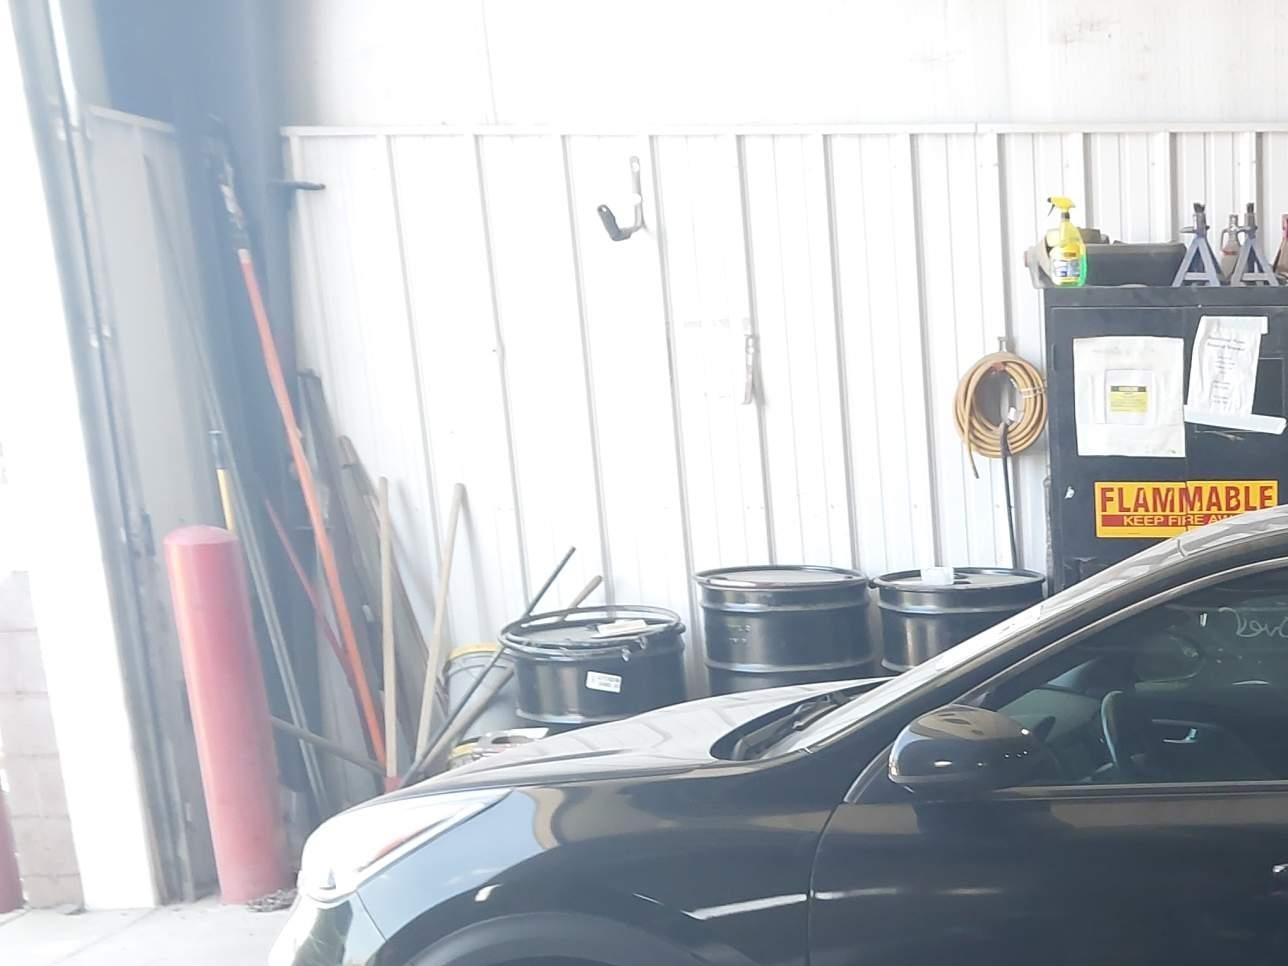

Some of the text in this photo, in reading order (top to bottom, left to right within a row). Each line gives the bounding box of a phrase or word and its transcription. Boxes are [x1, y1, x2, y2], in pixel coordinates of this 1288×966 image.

[1100, 486, 1273, 512] FLAMMABLE
[1123, 515, 1165, 526] KEEP
[1168, 514, 1204, 526] FIRE
